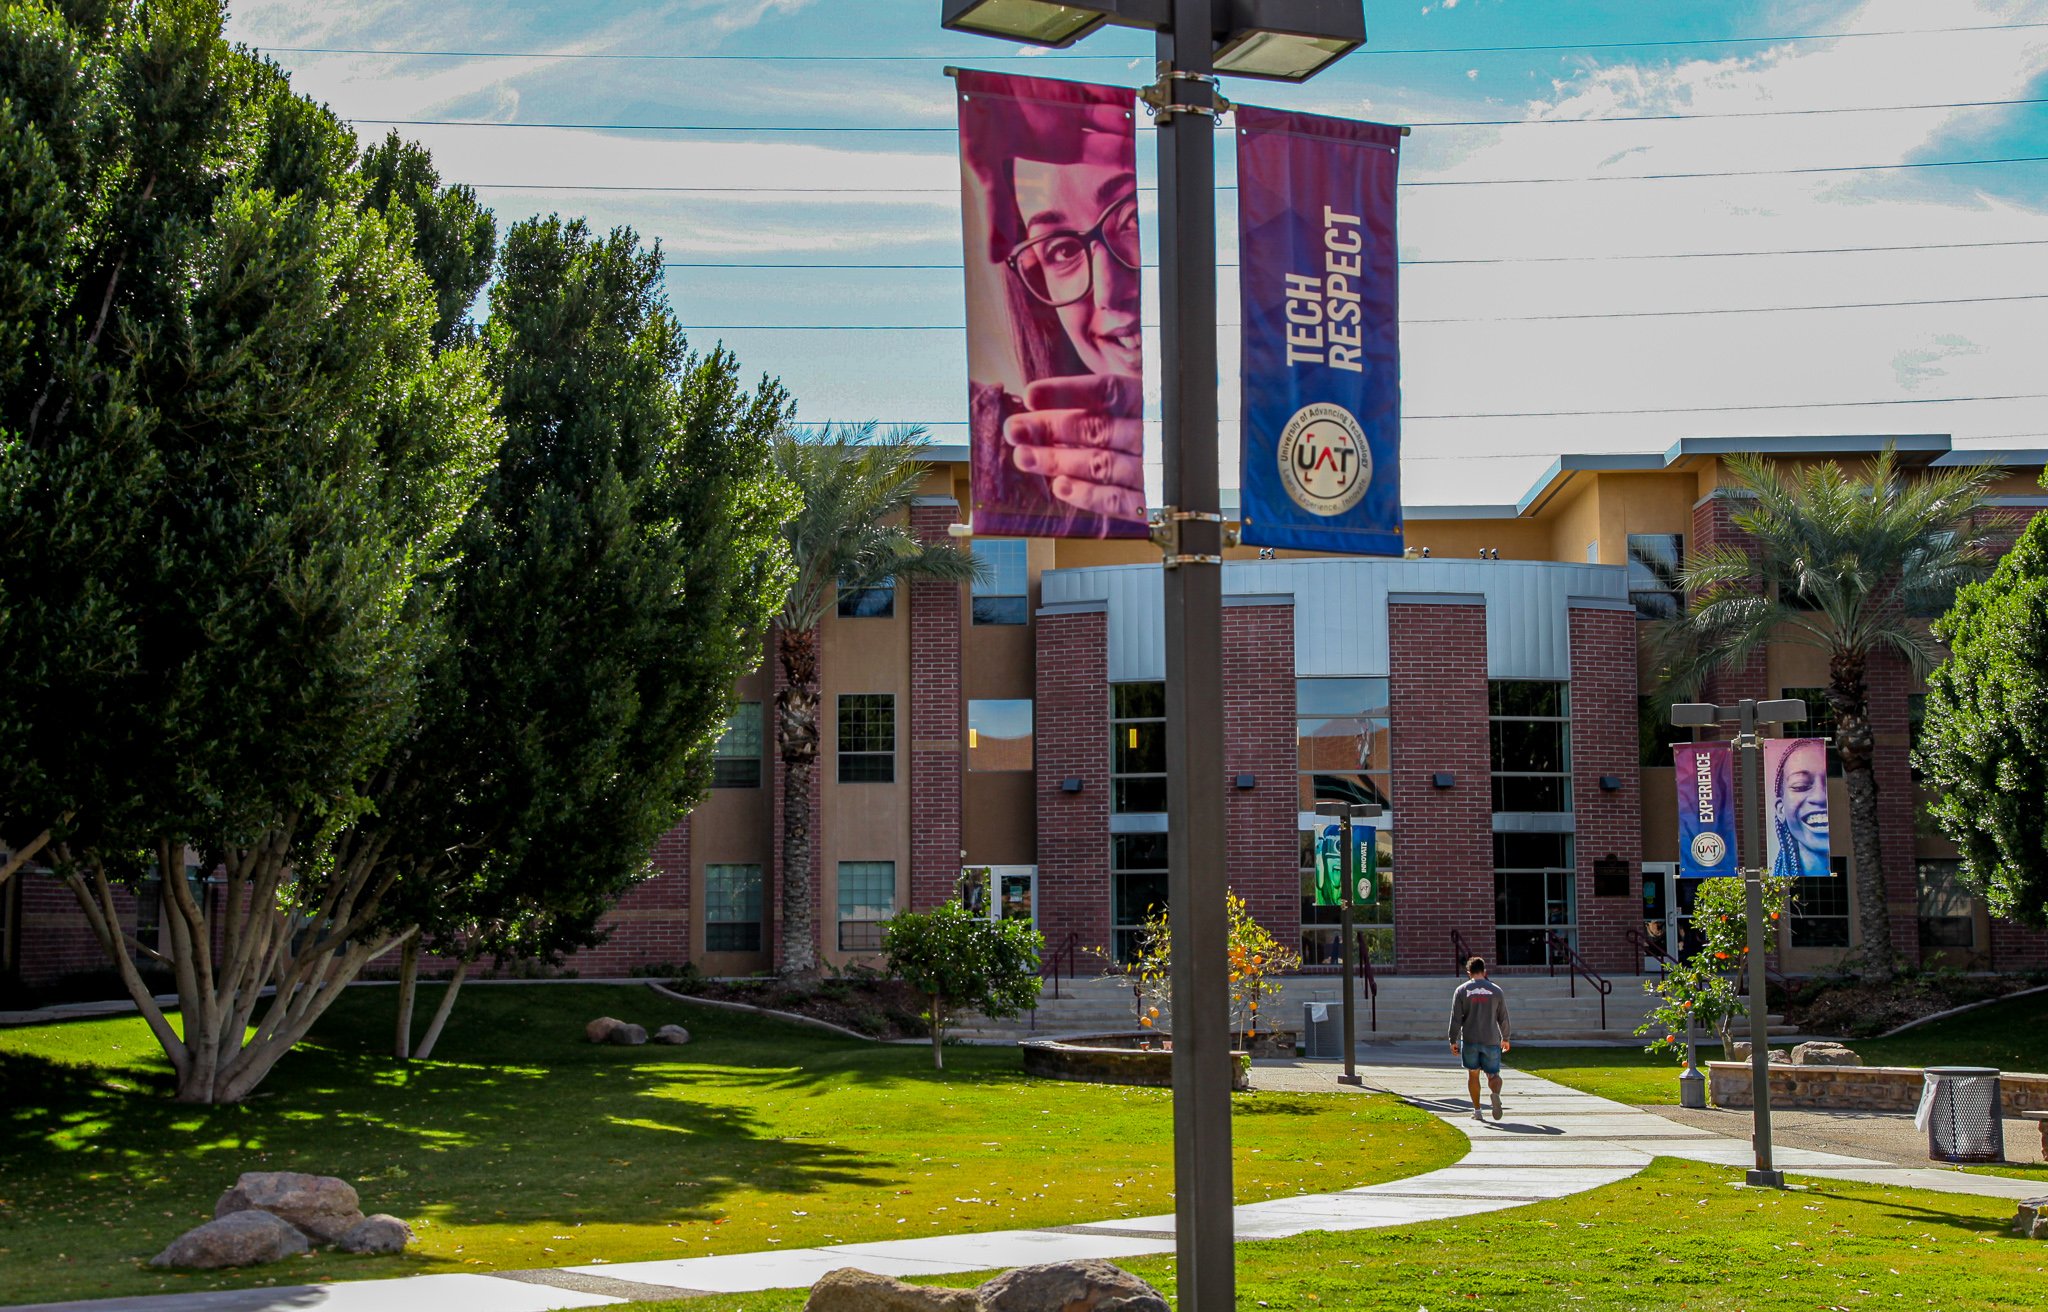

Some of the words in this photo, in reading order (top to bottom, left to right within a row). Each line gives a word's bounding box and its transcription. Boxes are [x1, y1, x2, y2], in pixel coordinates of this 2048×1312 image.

[1285, 273, 1324, 367] TECH
[1324, 205, 1362, 373] RESPECT
[1281, 421, 1301, 462] University
[1300, 412, 1308, 422] of
[1309, 407, 1349, 424] Advancing
[1348, 420, 1369, 469] Technology
[1298, 444, 1354, 473] UAT
[1696, 752, 1714, 823] EXPERIENCE
[1697, 845, 1718, 854] UAT
